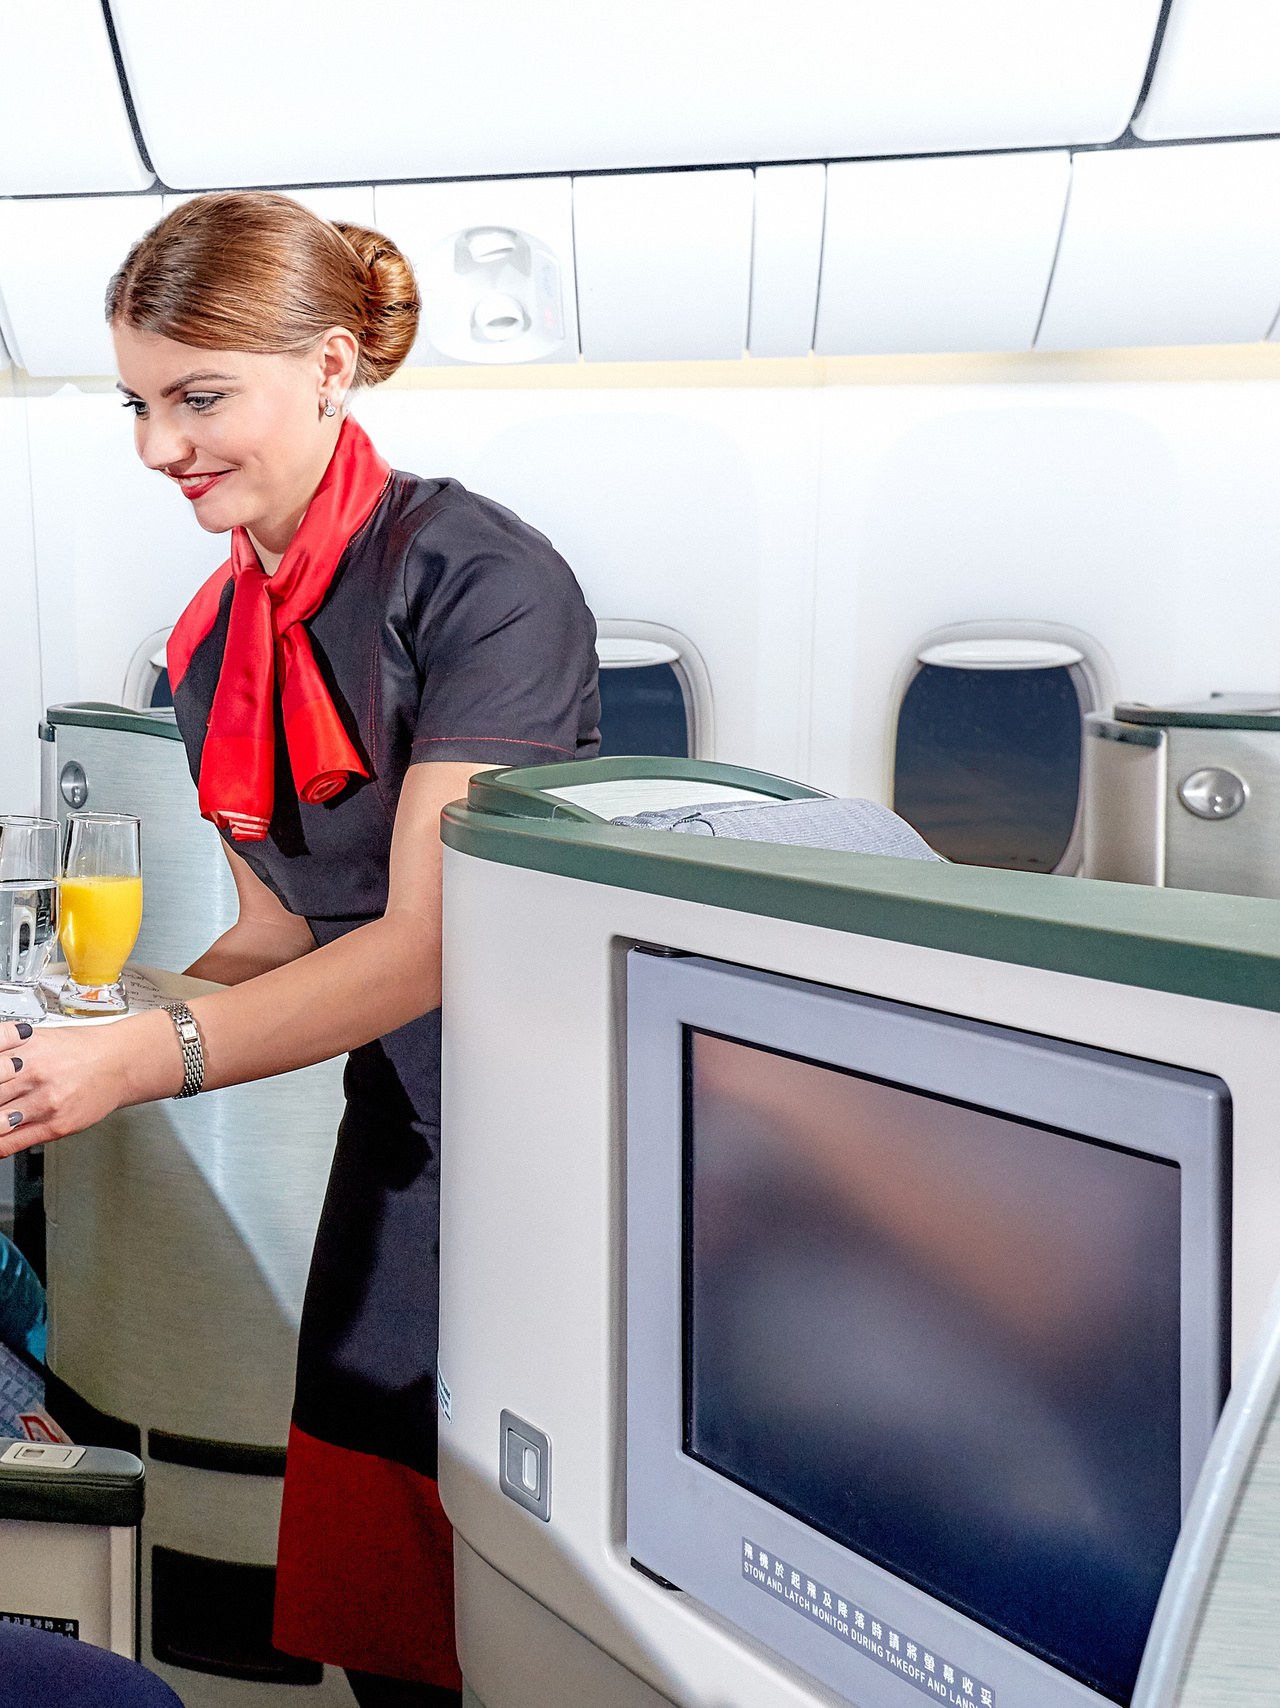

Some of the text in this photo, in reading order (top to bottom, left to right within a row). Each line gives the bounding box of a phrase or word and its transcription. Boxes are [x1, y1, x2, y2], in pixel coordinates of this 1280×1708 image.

[744, 1561, 979, 1708] STOW AND LATCH MONITOR DURING TAKEOFF AND LAND
